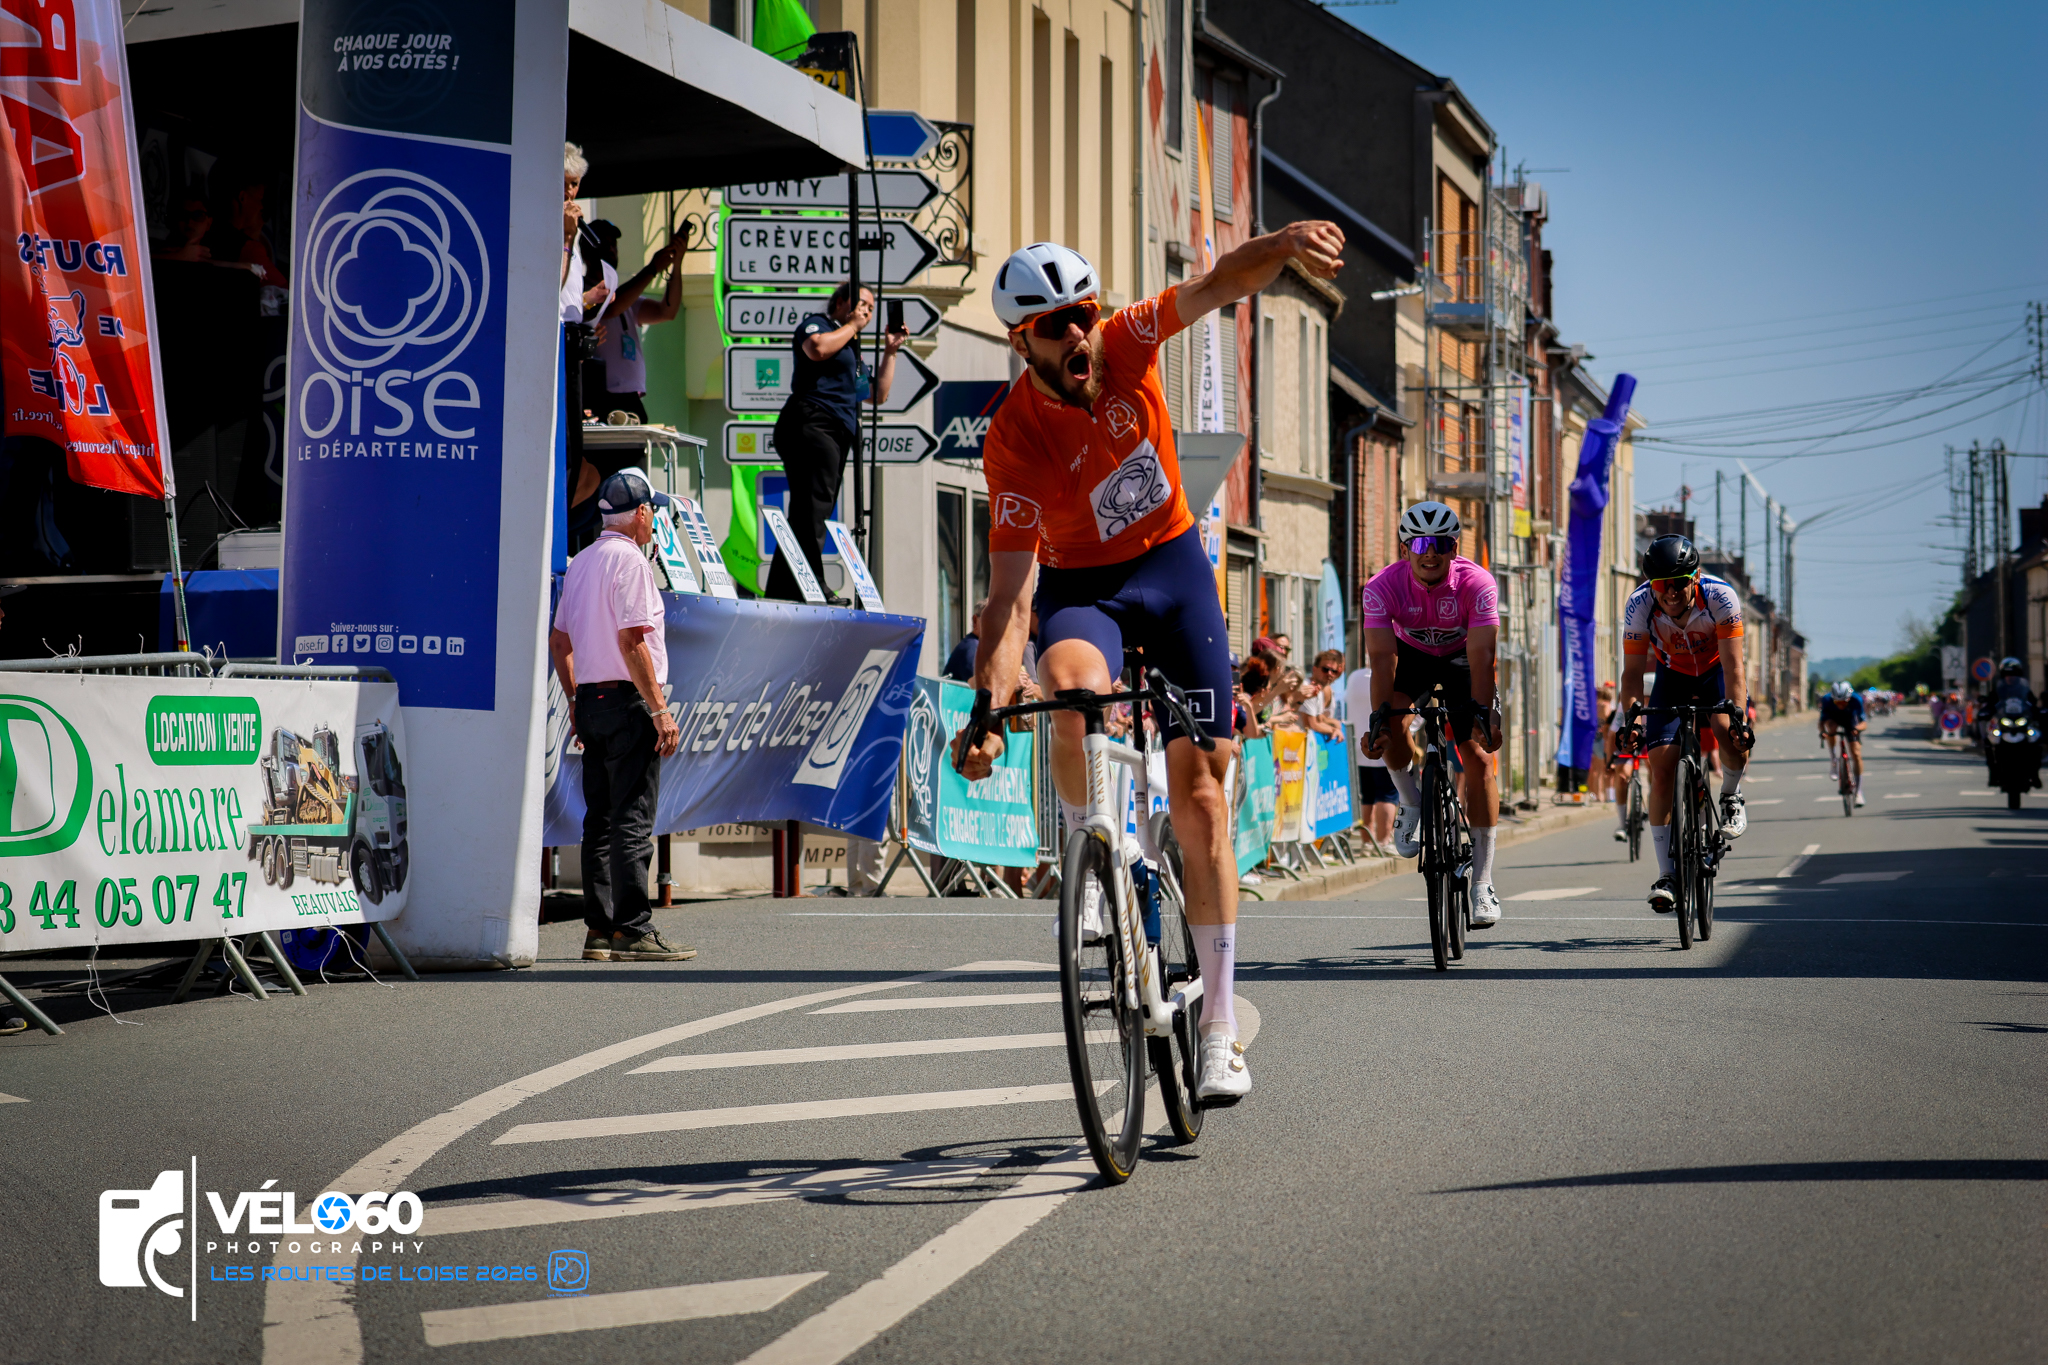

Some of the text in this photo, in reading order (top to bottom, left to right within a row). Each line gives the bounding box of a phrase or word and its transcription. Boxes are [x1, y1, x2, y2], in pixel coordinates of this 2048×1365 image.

[334, 33, 452, 52] CHAQUE JOUR
[337, 49, 460, 72] À VOS CÔTÉS !
[739, 179, 822, 197] CONTY
[739, 255, 850, 274] LE GRAND
[300, 369, 481, 440] oise
[940, 416, 992, 448] AXA
[298, 439, 479, 461] LE DÉPARTEMENT
[331, 622, 377, 633] Suivez-nous
[379, 625, 394, 633] sur
[1624, 632, 1642, 641] ISE
[298, 638, 325, 652] oise.fr
[1564, 615, 1590, 721] CHAQUE JOUR
[727, 681, 772, 751] de
[153, 712, 216, 752] LOCATION
[222, 713, 256, 752] VENTE
[942, 805, 979, 845] S'ENGAGE
[980, 811, 995, 847] POUR
[997, 813, 1006, 847] LE
[1006, 814, 1035, 848] SPORT
[29, 880, 80, 930] 44
[95, 877, 142, 928] 05
[152, 874, 199, 924] 07
[213, 871, 247, 919] 47
[291, 890, 360, 916] BEAUVAIS
